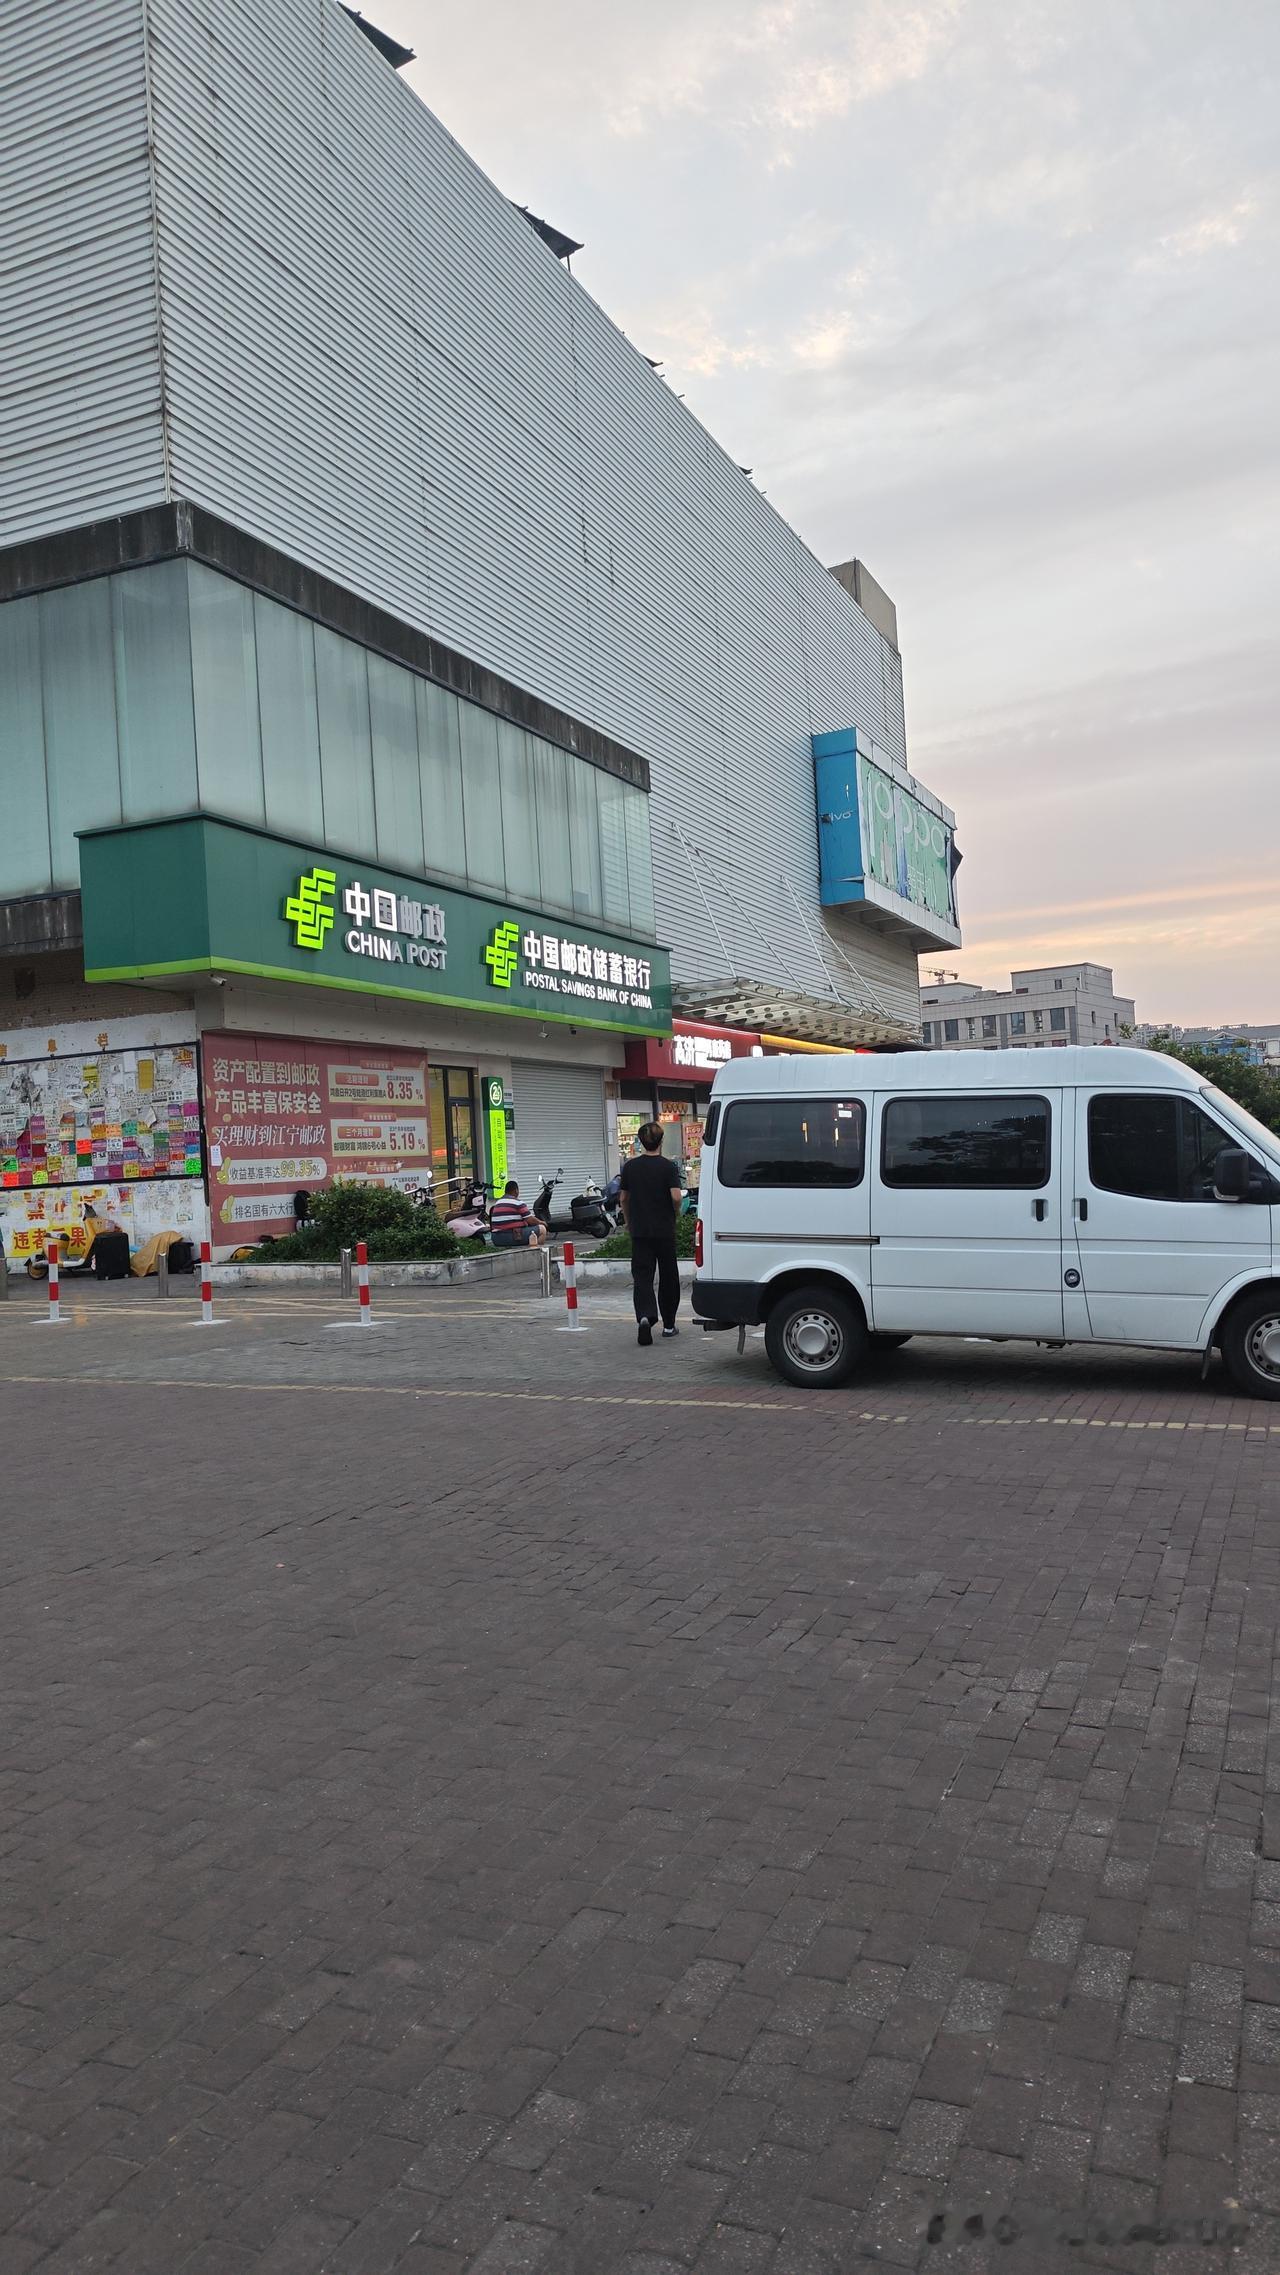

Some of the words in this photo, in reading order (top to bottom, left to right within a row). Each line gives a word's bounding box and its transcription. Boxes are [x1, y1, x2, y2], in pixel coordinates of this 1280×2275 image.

[343, 881, 447, 945] 中国邮政
[345, 930, 403, 962] CHINA
[406, 943, 447, 969] POST
[523, 930, 650, 990] 中国邮政储蓄银行
[525, 971, 560, 991] POSTAL
[561, 979, 596, 999] SAVINGS
[597, 987, 618, 1004] BANK
[618, 990, 630, 1005] OF
[630, 992, 653, 1010] CHINA
[213, 1058, 320, 1086] 资产配置到邮政
[214, 1088, 322, 1114] 产品丰富保安全
[215, 1124, 326, 1147] 买理财到江宁邮政
